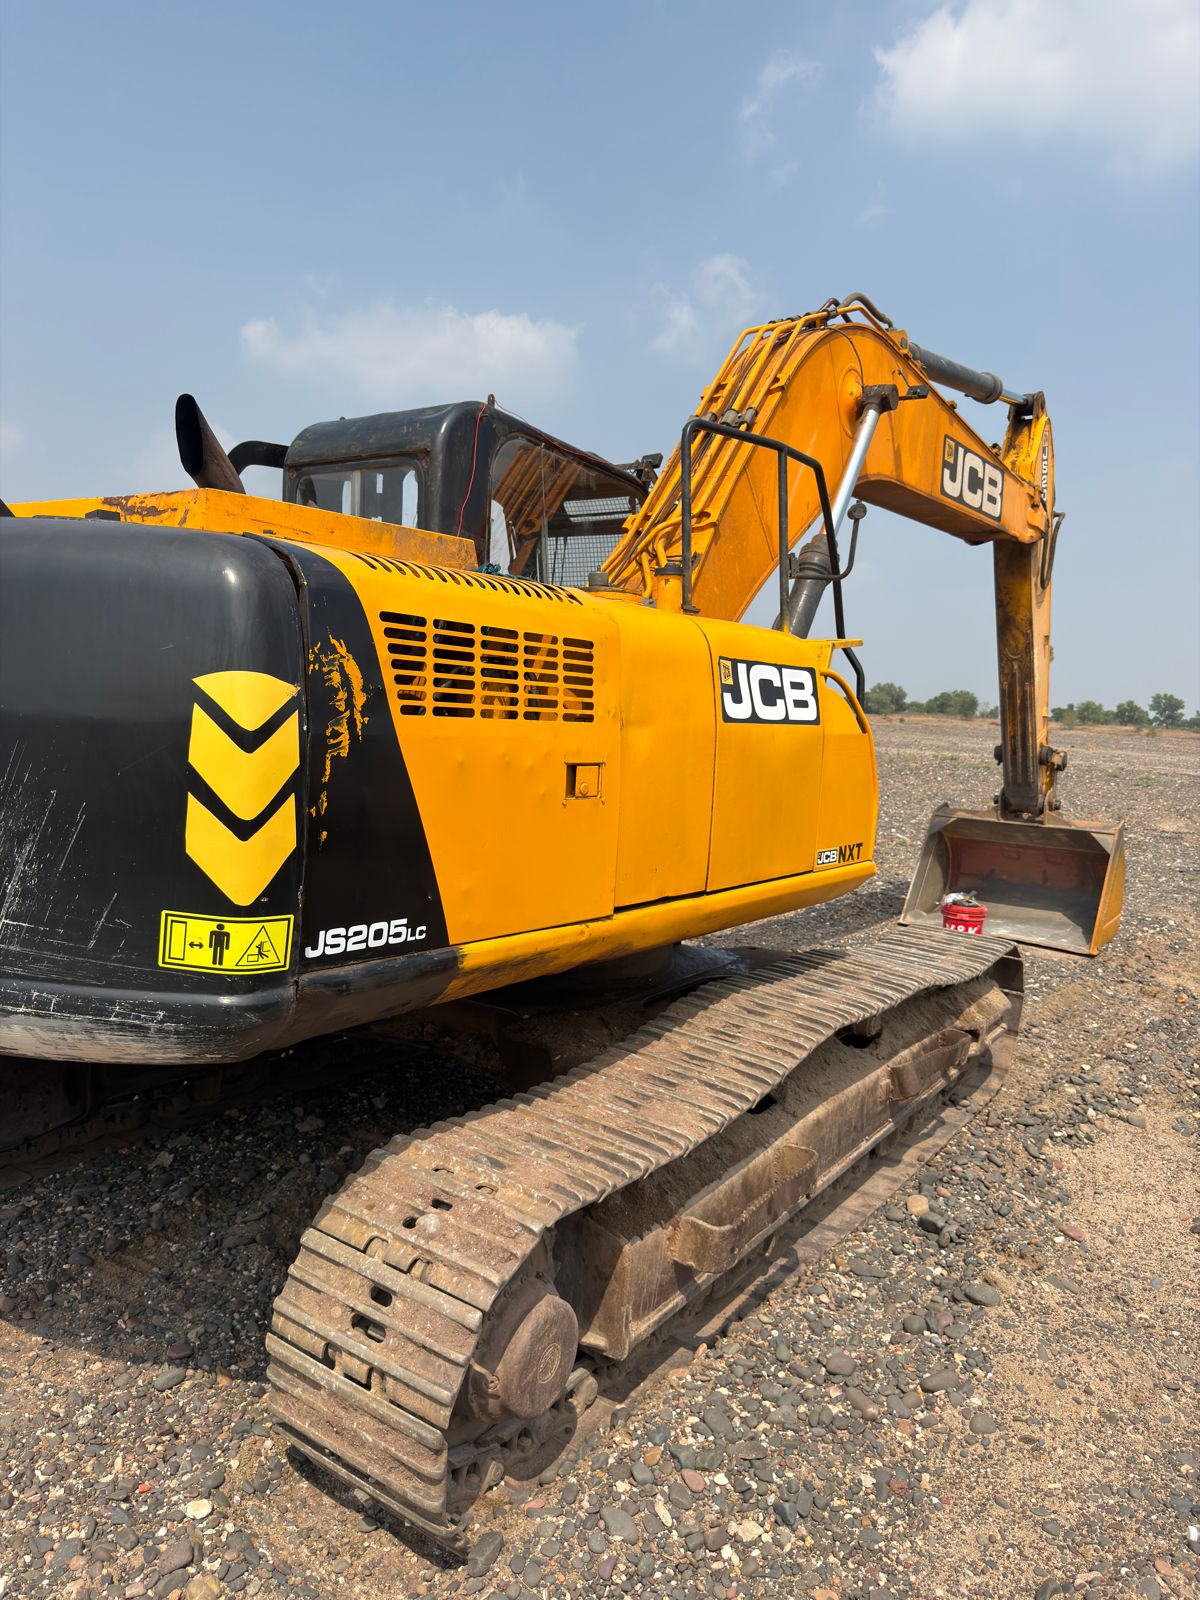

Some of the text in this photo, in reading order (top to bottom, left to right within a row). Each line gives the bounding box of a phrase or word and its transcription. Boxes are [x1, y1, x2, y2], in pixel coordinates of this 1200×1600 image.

[943, 446, 1003, 518] JCB
[723, 662, 818, 721] JCB
[817, 842, 864, 864] JCB NXT
